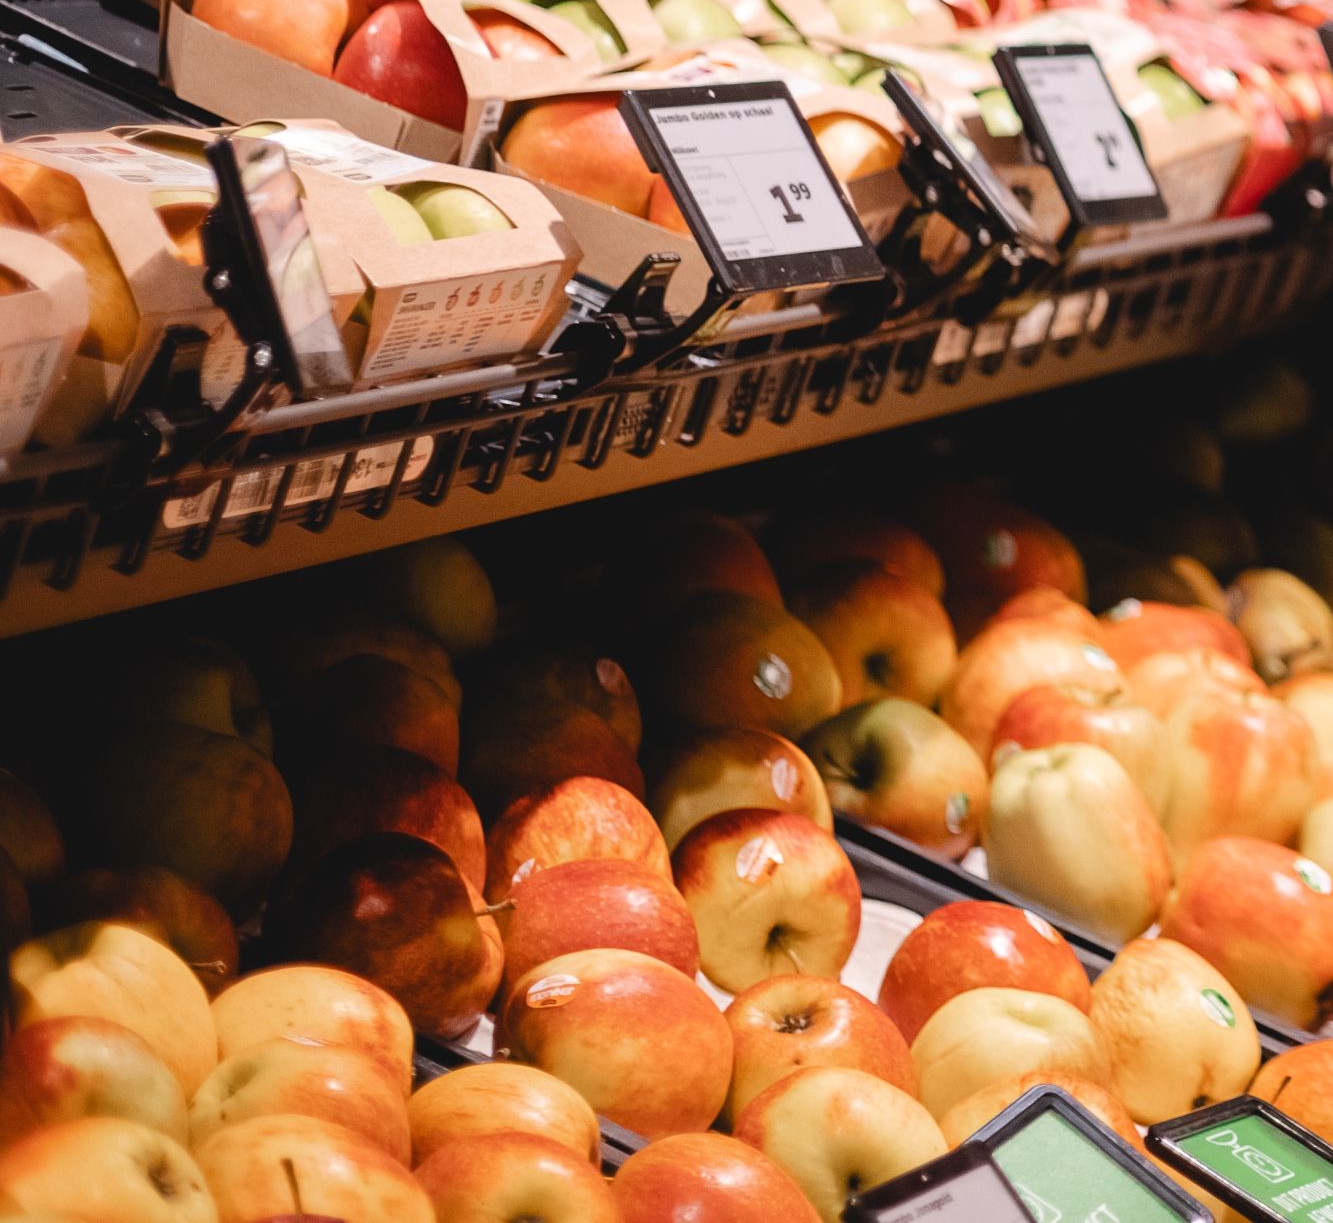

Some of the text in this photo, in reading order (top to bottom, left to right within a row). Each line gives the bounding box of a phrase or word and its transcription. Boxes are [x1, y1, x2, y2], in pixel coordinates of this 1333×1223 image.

[656, 107, 774, 124] Jumbo Golden op schaal
[1271, 1192, 1302, 1213] DIT
